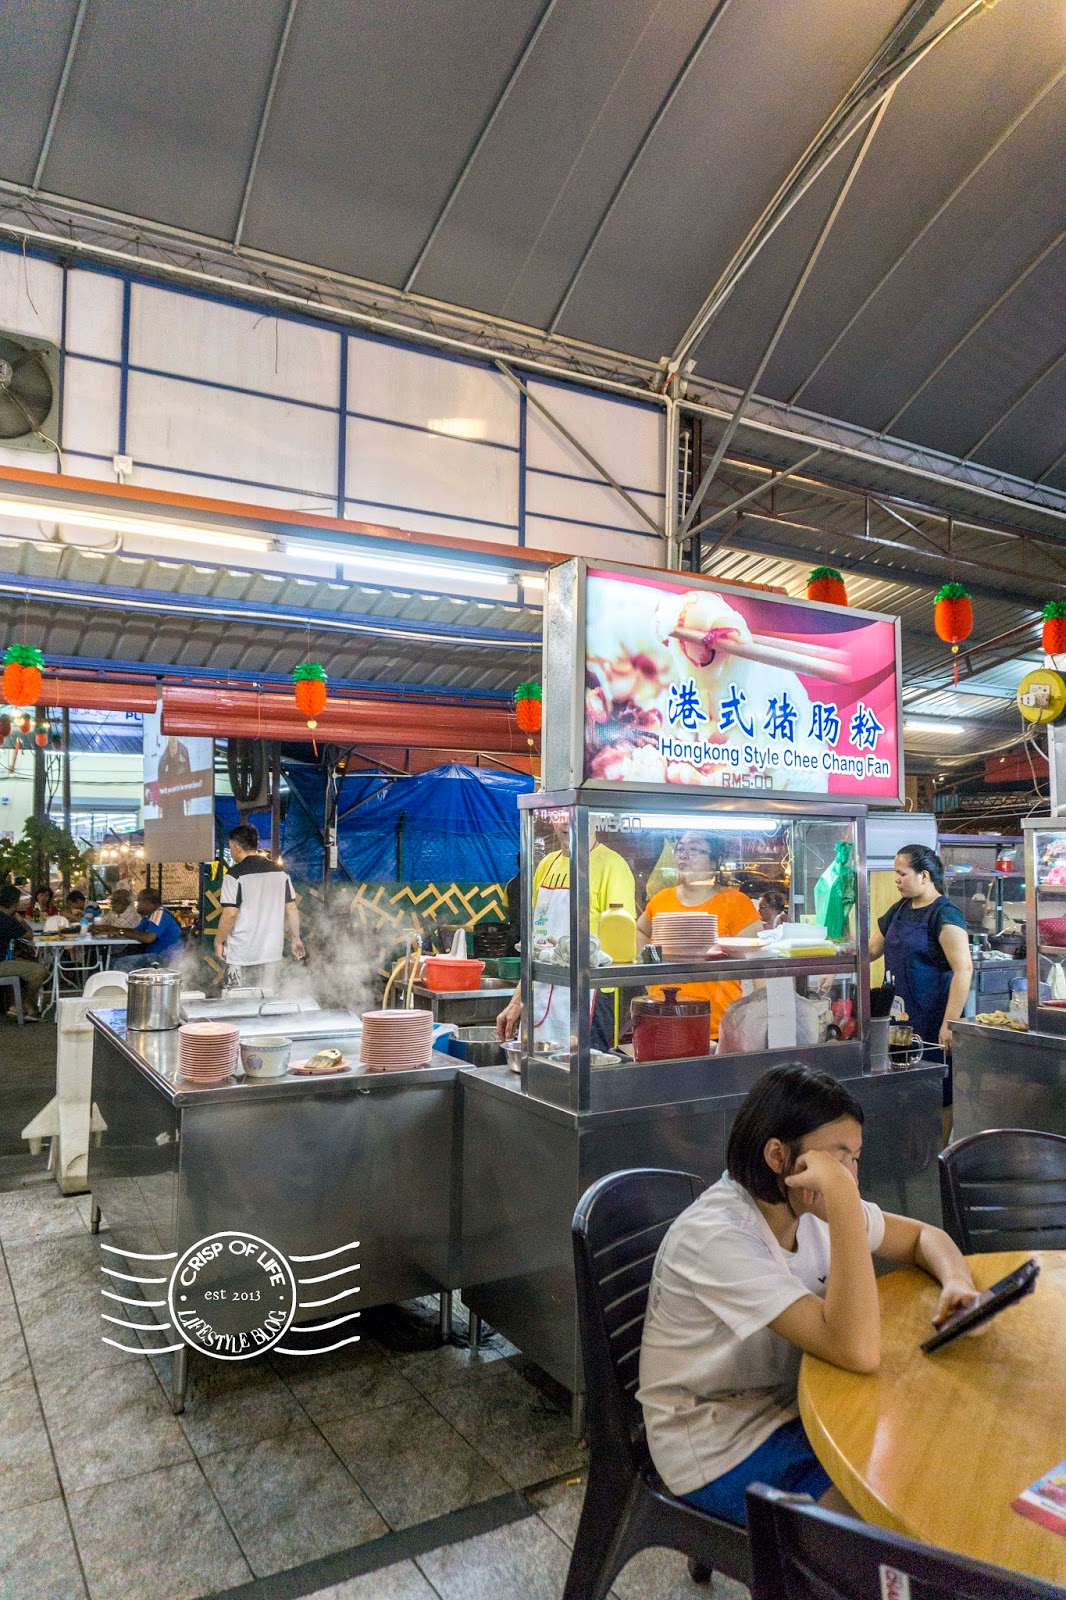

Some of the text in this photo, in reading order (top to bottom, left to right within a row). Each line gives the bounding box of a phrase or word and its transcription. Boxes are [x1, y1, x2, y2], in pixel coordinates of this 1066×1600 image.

[668, 680, 883, 748] 港式猪肠粉
[661, 737, 889, 776] Hongkong Style Chee Chang Fan
